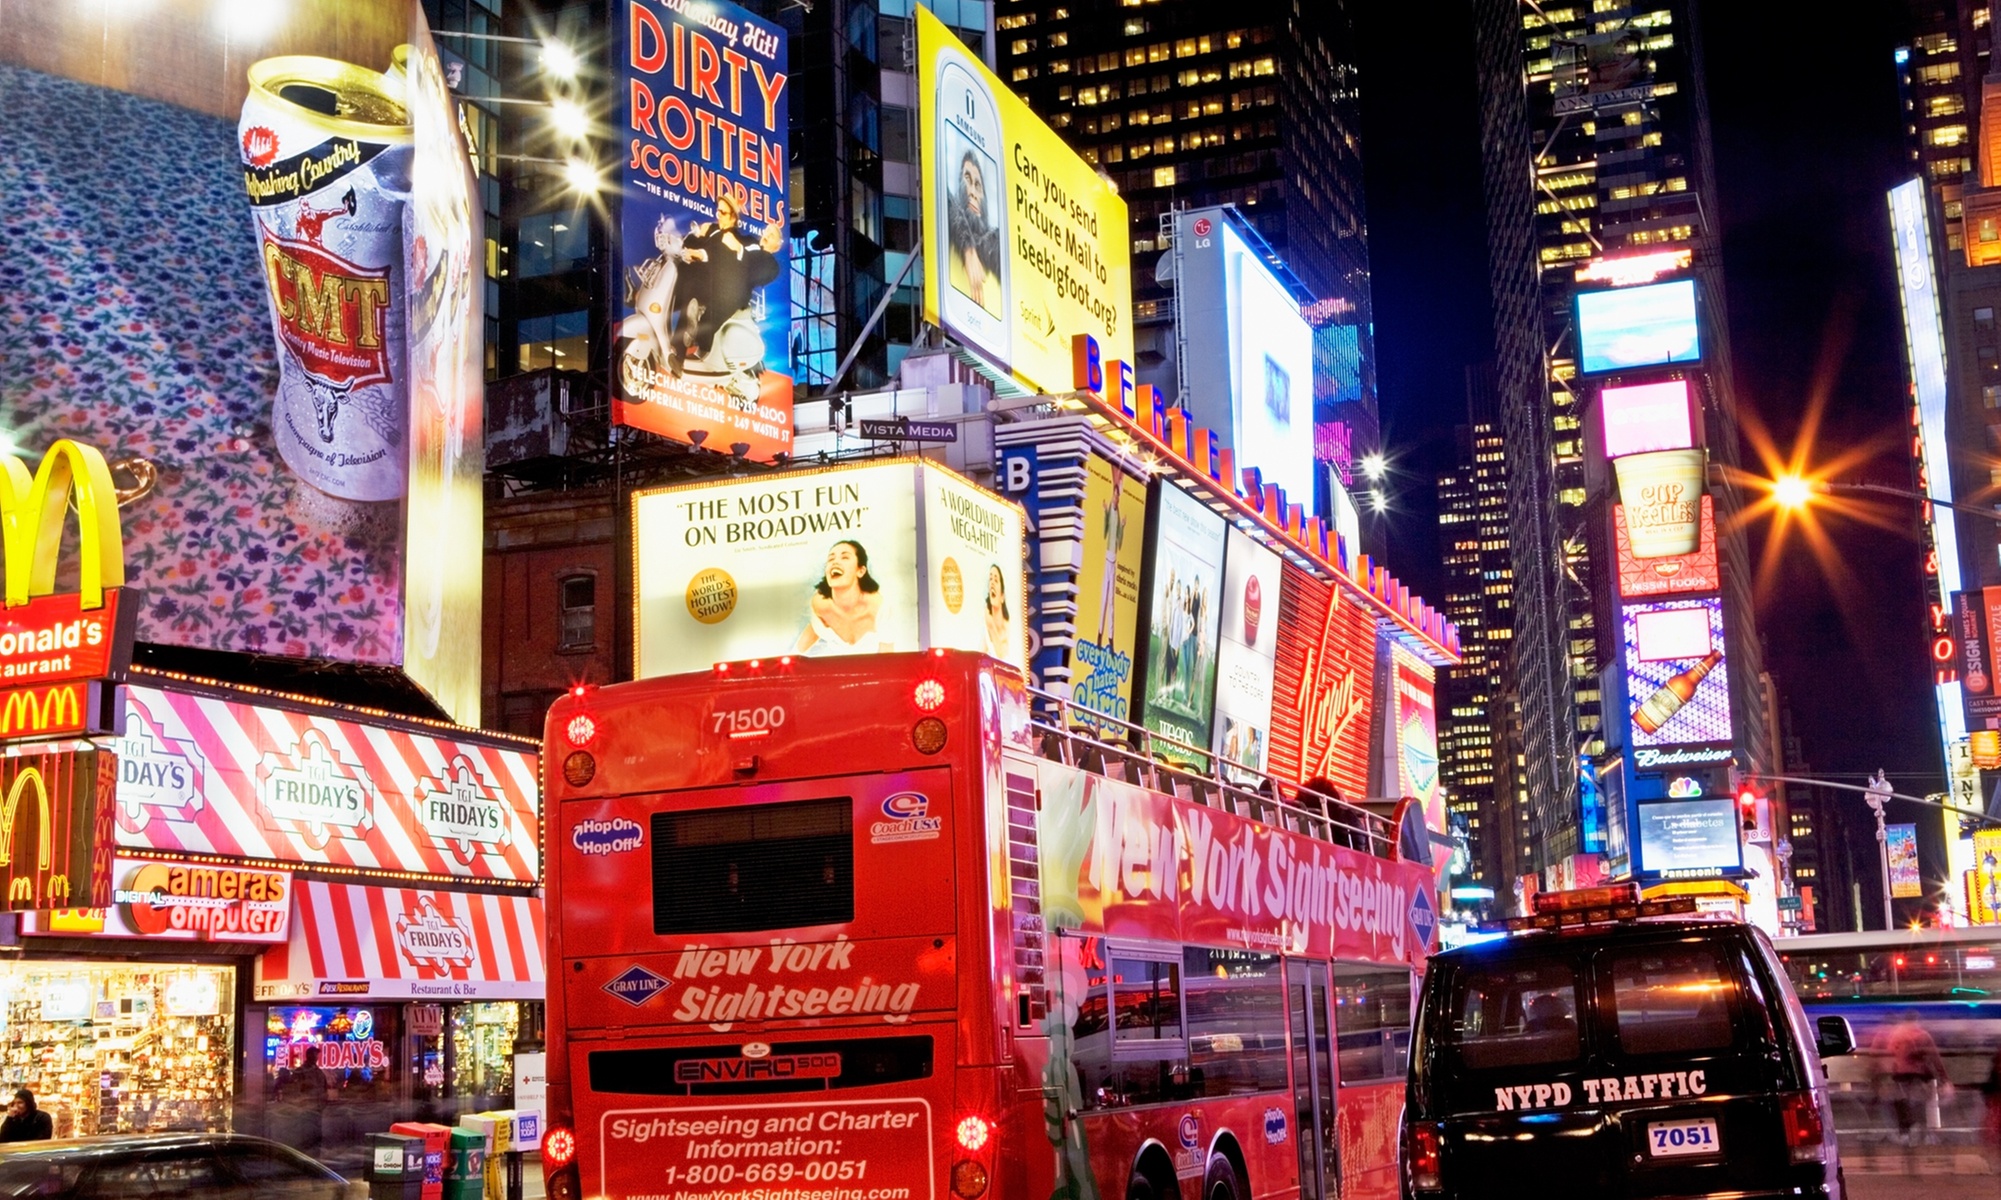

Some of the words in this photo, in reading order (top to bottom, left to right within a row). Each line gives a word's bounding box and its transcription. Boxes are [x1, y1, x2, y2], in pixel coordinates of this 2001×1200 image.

[742, 22, 779, 60] Hit!
[630, 0, 788, 131] DIRTY
[630, 77, 784, 194] ROTTEN
[956, 113, 986, 148] SAMSUNG
[300, 140, 361, 191] Country
[630, 138, 785, 229] SCOUNDRELS
[1014, 142, 1040, 188] Can
[1042, 173, 1067, 211] you
[1069, 198, 1098, 240] send
[663, 189, 681, 204] NEW
[682, 197, 714, 218] MUSICAL
[1016, 183, 1062, 247] Picture
[1065, 227, 1092, 273] Mail
[1095, 255, 1108, 285] to
[1195, 238, 1212, 249] LG
[1017, 225, 1118, 338] iseebigfoot.org?
[262, 241, 391, 350] CMT
[307, 341, 330, 361] Music
[330, 349, 371, 369] Television
[631, 366, 725, 407] TELECHARGE.COM
[639, 387, 684, 412] IMPERIAL
[686, 401, 725, 424] THEATRE
[734, 415, 750, 431] 249
[781, 429, 790, 443] ST
[337, 448, 387, 468] Television
[737, 489, 804, 514] MOST
[814, 482, 860, 507] FUN
[1640, 482, 1684, 507] CUP
[948, 490, 1005, 537] WORLDWIDE
[684, 526, 717, 548] ON
[691, 578, 732, 597] WORLD'S
[700, 573, 717, 585] THE
[1631, 579, 1667, 592] NISSIN
[1669, 576, 1707, 588] FOODS
[690, 587, 735, 609] HOTTEST
[697, 600, 733, 619] SHOW!
[1960, 594, 1969, 618] SQUARE
[1964, 618, 1973, 639] TIMES
[1076, 638, 1131, 683] everybody
[1964, 639, 1983, 687] DESIGN
[1093, 667, 1118, 691] hates
[1968, 700, 1985, 708] CAST
[711, 705, 786, 734] 71500
[1634, 748, 1732, 767] Budweiser
[274, 778, 359, 812] FRIDAY'S
[428, 804, 499, 829] FRIDAY'S
[583, 819, 612, 835] Hop
[612, 817, 633, 831] On
[582, 840, 612, 856] Hop
[612, 837, 633, 852] Off
[1088, 793, 1177, 902] New
[1189, 806, 1261, 916] York
[1264, 829, 1406, 962] Sightseeing
[1660, 866, 1723, 879] Panasonic
[114, 889, 166, 905] DIGITAL
[409, 930, 462, 949] FRIDAY'S
[673, 944, 762, 979] New
[768, 933, 855, 975] York
[261, 981, 311, 997] FRIDAY'S
[410, 982, 452, 995] Restaurant
[453, 983, 461, 995] &
[463, 983, 477, 995] Bar
[612, 979, 639, 993] GRAY
[639, 977, 660, 991] LINE
[413, 1008, 437, 1023] ATM
[673, 976, 920, 1033] Sightseeing
[1494, 1081, 1572, 1112] NYPD
[1583, 1069, 1707, 1104] TRAFFIC
[520, 1128, 536, 1137] TODAY
[524, 1120, 536, 1129] USA
[610, 1114, 760, 1143] Sightseeing
[763, 1111, 813, 1134] and
[817, 1109, 919, 1132] Charter
[685, 1136, 842, 1160] Information:
[1653, 1126, 1713, 1149] 7051
[664, 1159, 867, 1185] 1-800-669-0051
